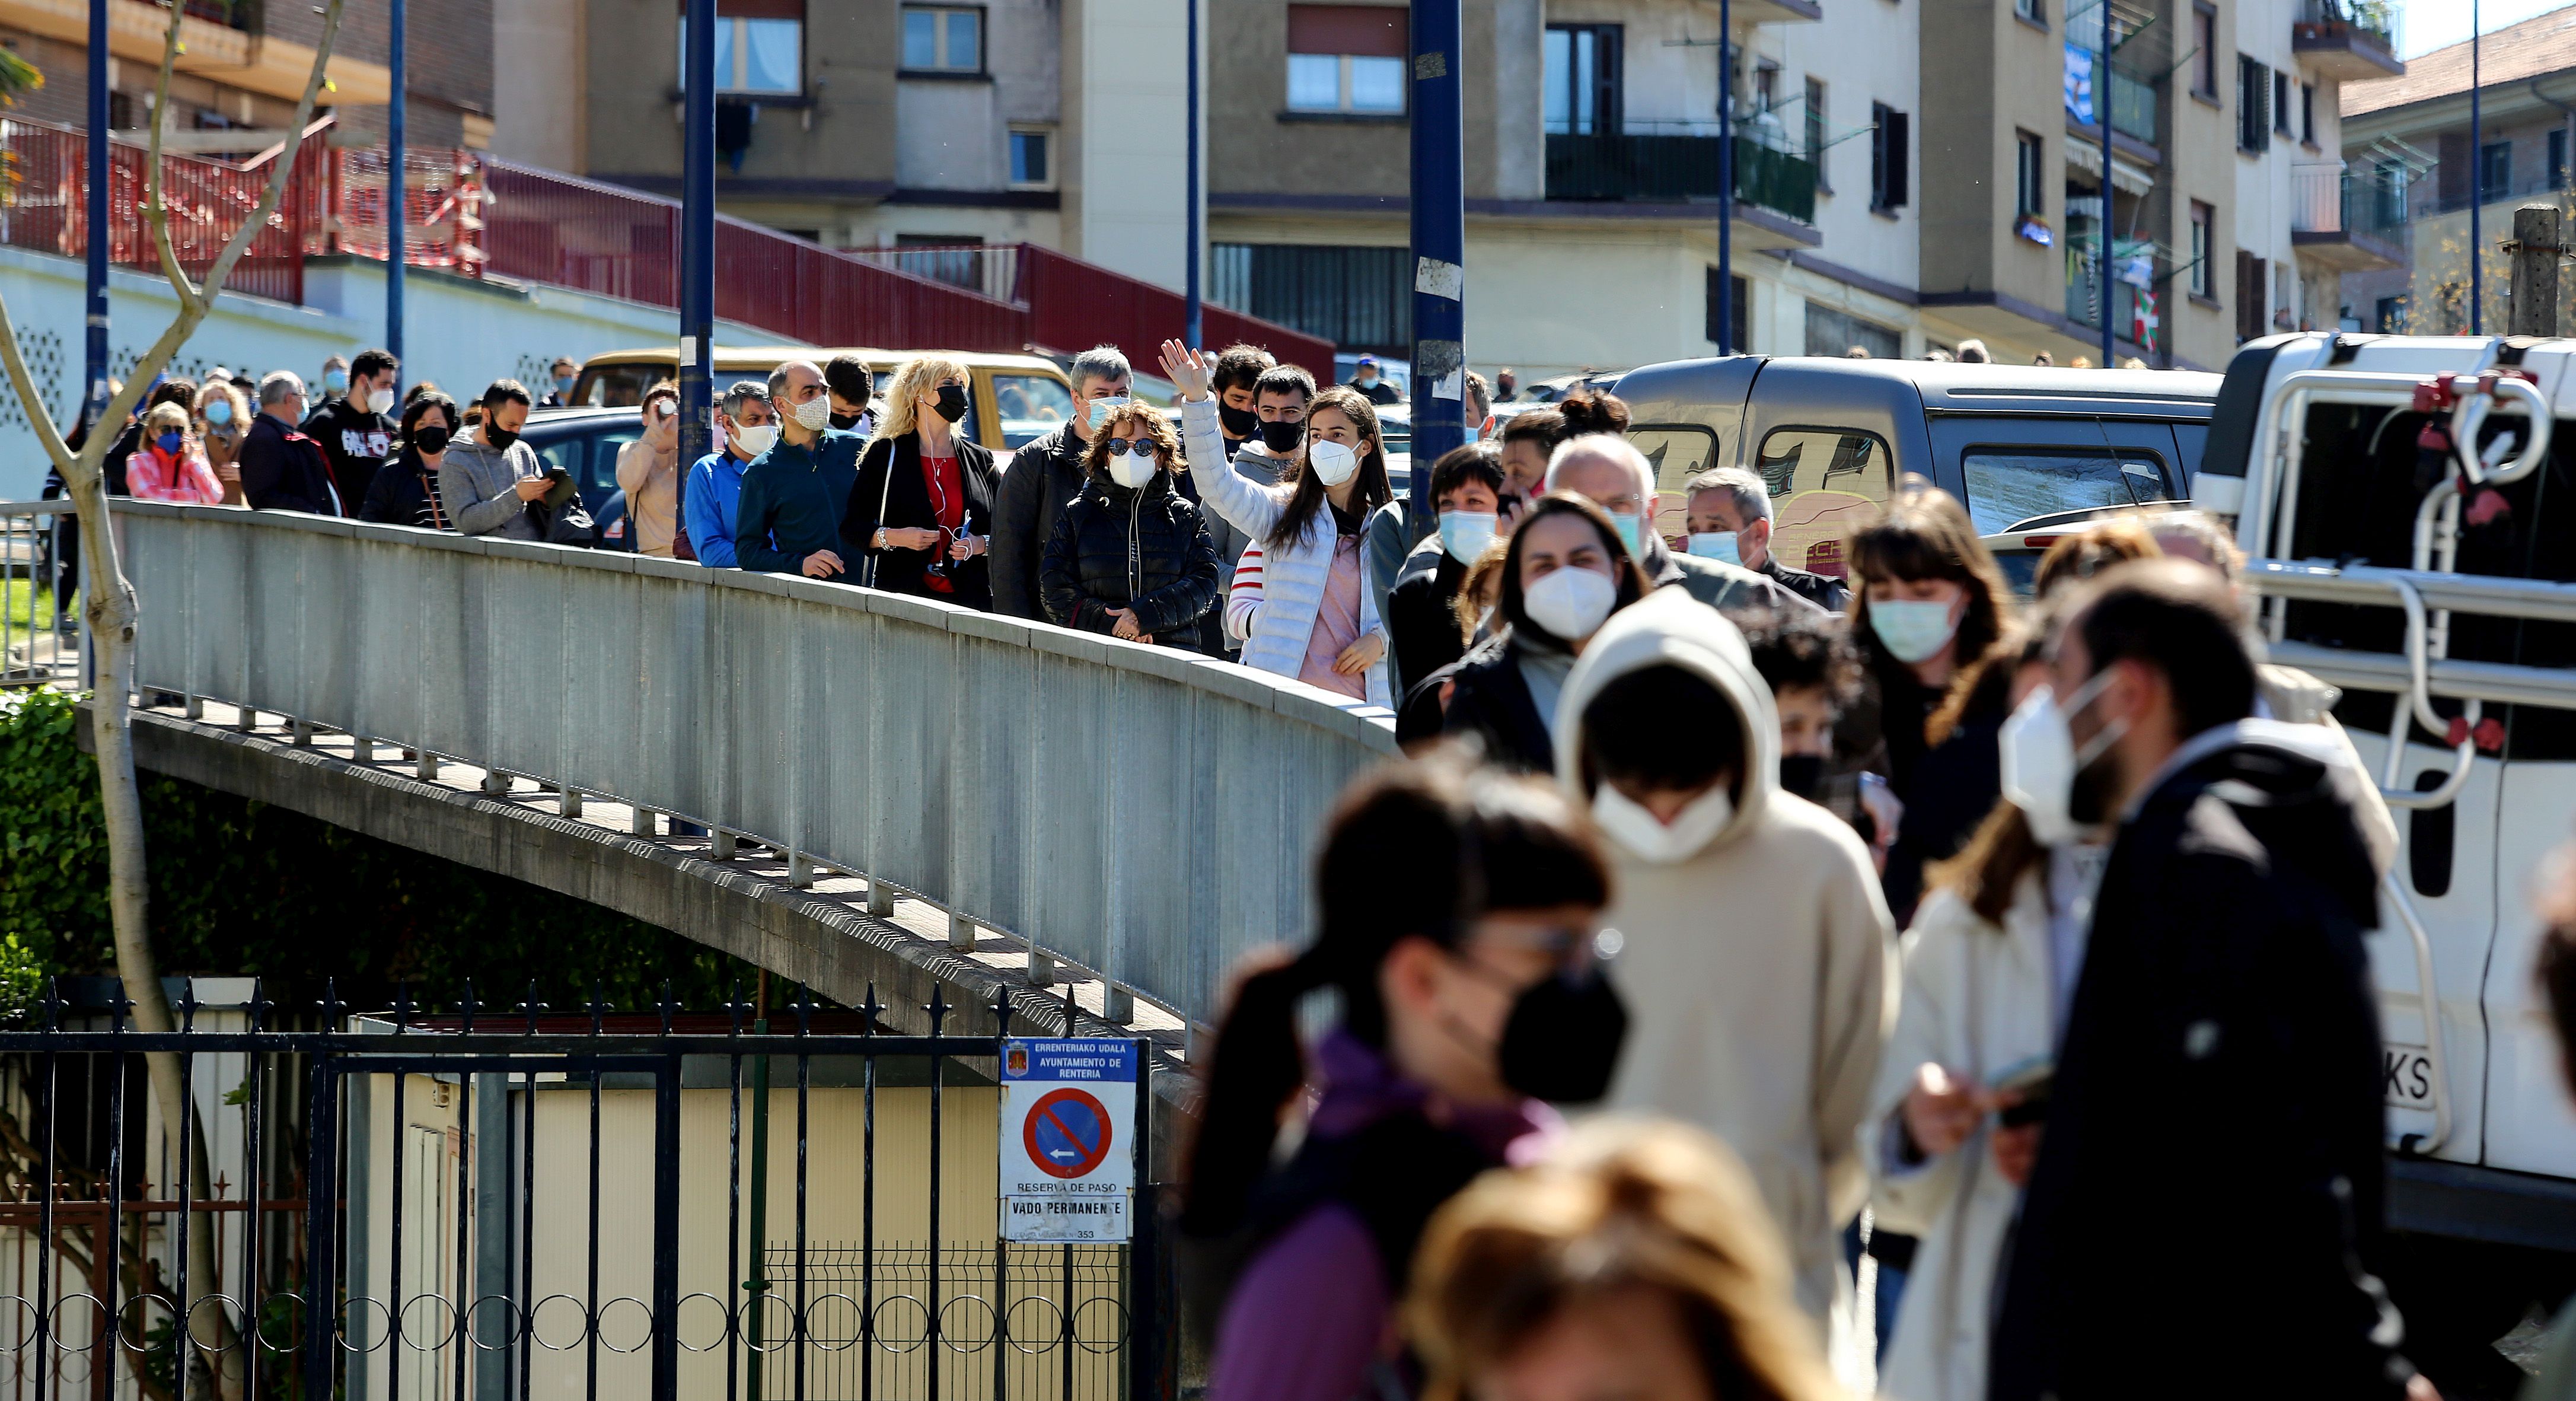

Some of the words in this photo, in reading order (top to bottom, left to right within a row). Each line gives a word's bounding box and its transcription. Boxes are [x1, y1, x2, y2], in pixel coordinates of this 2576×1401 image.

[1035, 1043, 1096, 1053] ERRENTERIAKO
[1099, 1044, 1126, 1053] UDALA
[1040, 1058, 1106, 1068] AYUNTAMIENTO
[1109, 1058, 1121, 1068] DE
[1059, 1069, 1101, 1078] RENTERIA
[2384, 1052, 2431, 1099] KS
[1070, 1183, 1085, 1192] DE
[1089, 1183, 1117, 1192] PASO
[1013, 1202, 1041, 1214] VADO
[1047, 1202, 1120, 1214] PERMANENE
[1077, 1230, 1094, 1238] 353
